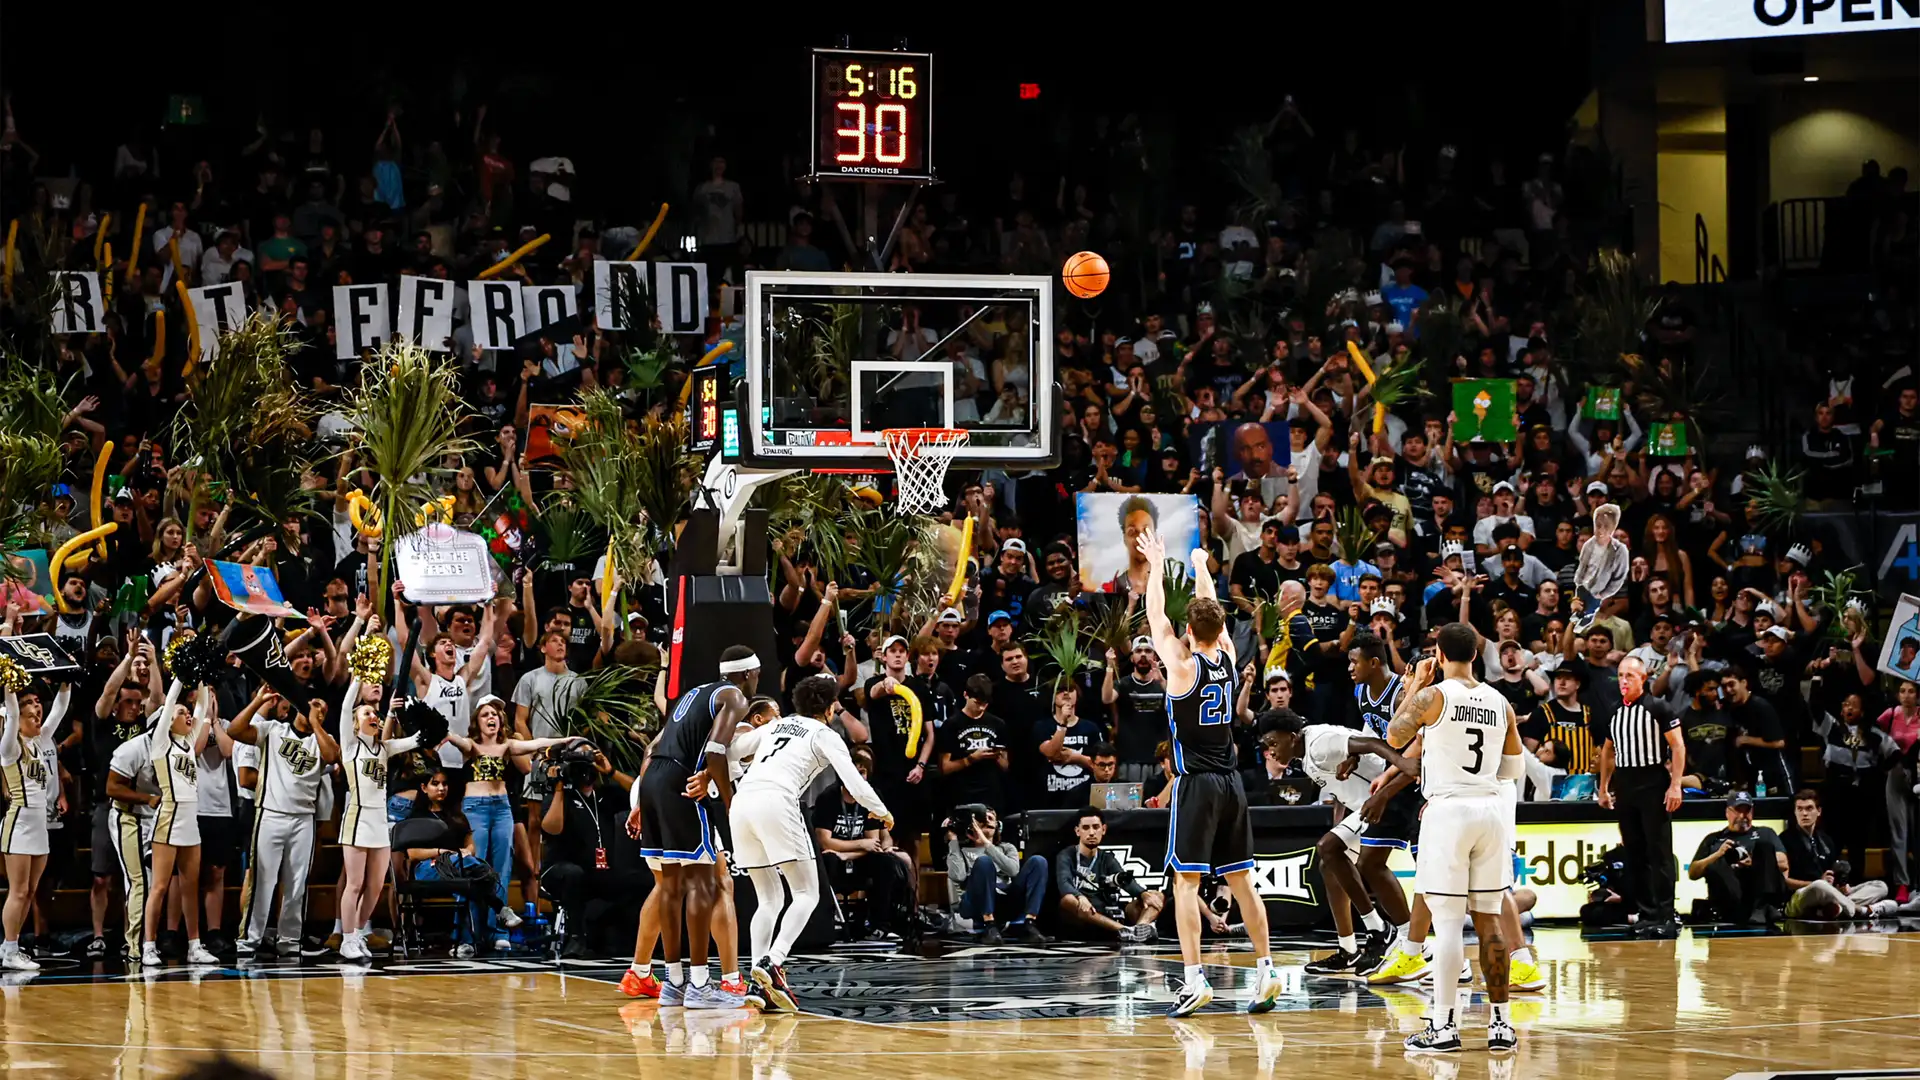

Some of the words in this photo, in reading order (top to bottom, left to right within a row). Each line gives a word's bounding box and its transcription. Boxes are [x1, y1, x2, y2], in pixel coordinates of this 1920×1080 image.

[845, 64, 917, 99] 5:16
[836, 102, 907, 163] 30
[412, 280, 445, 346] F
[486, 287, 517, 348] R
[671, 265, 700, 332] D
[763, 447, 793, 456] SPALDING
[5, 637, 56, 668] UCF
[449, 700, 456, 717] 1
[672, 687, 701, 723] 0
[1198, 681, 1233, 726] 21
[1450, 705, 1497, 727] JOHNSON
[770, 722, 810, 739] JOHNSON
[279, 736, 318, 775] UCF
[760, 737, 792, 763] 7
[1461, 727, 1484, 775] 3
[1254, 853, 1310, 899] XII
